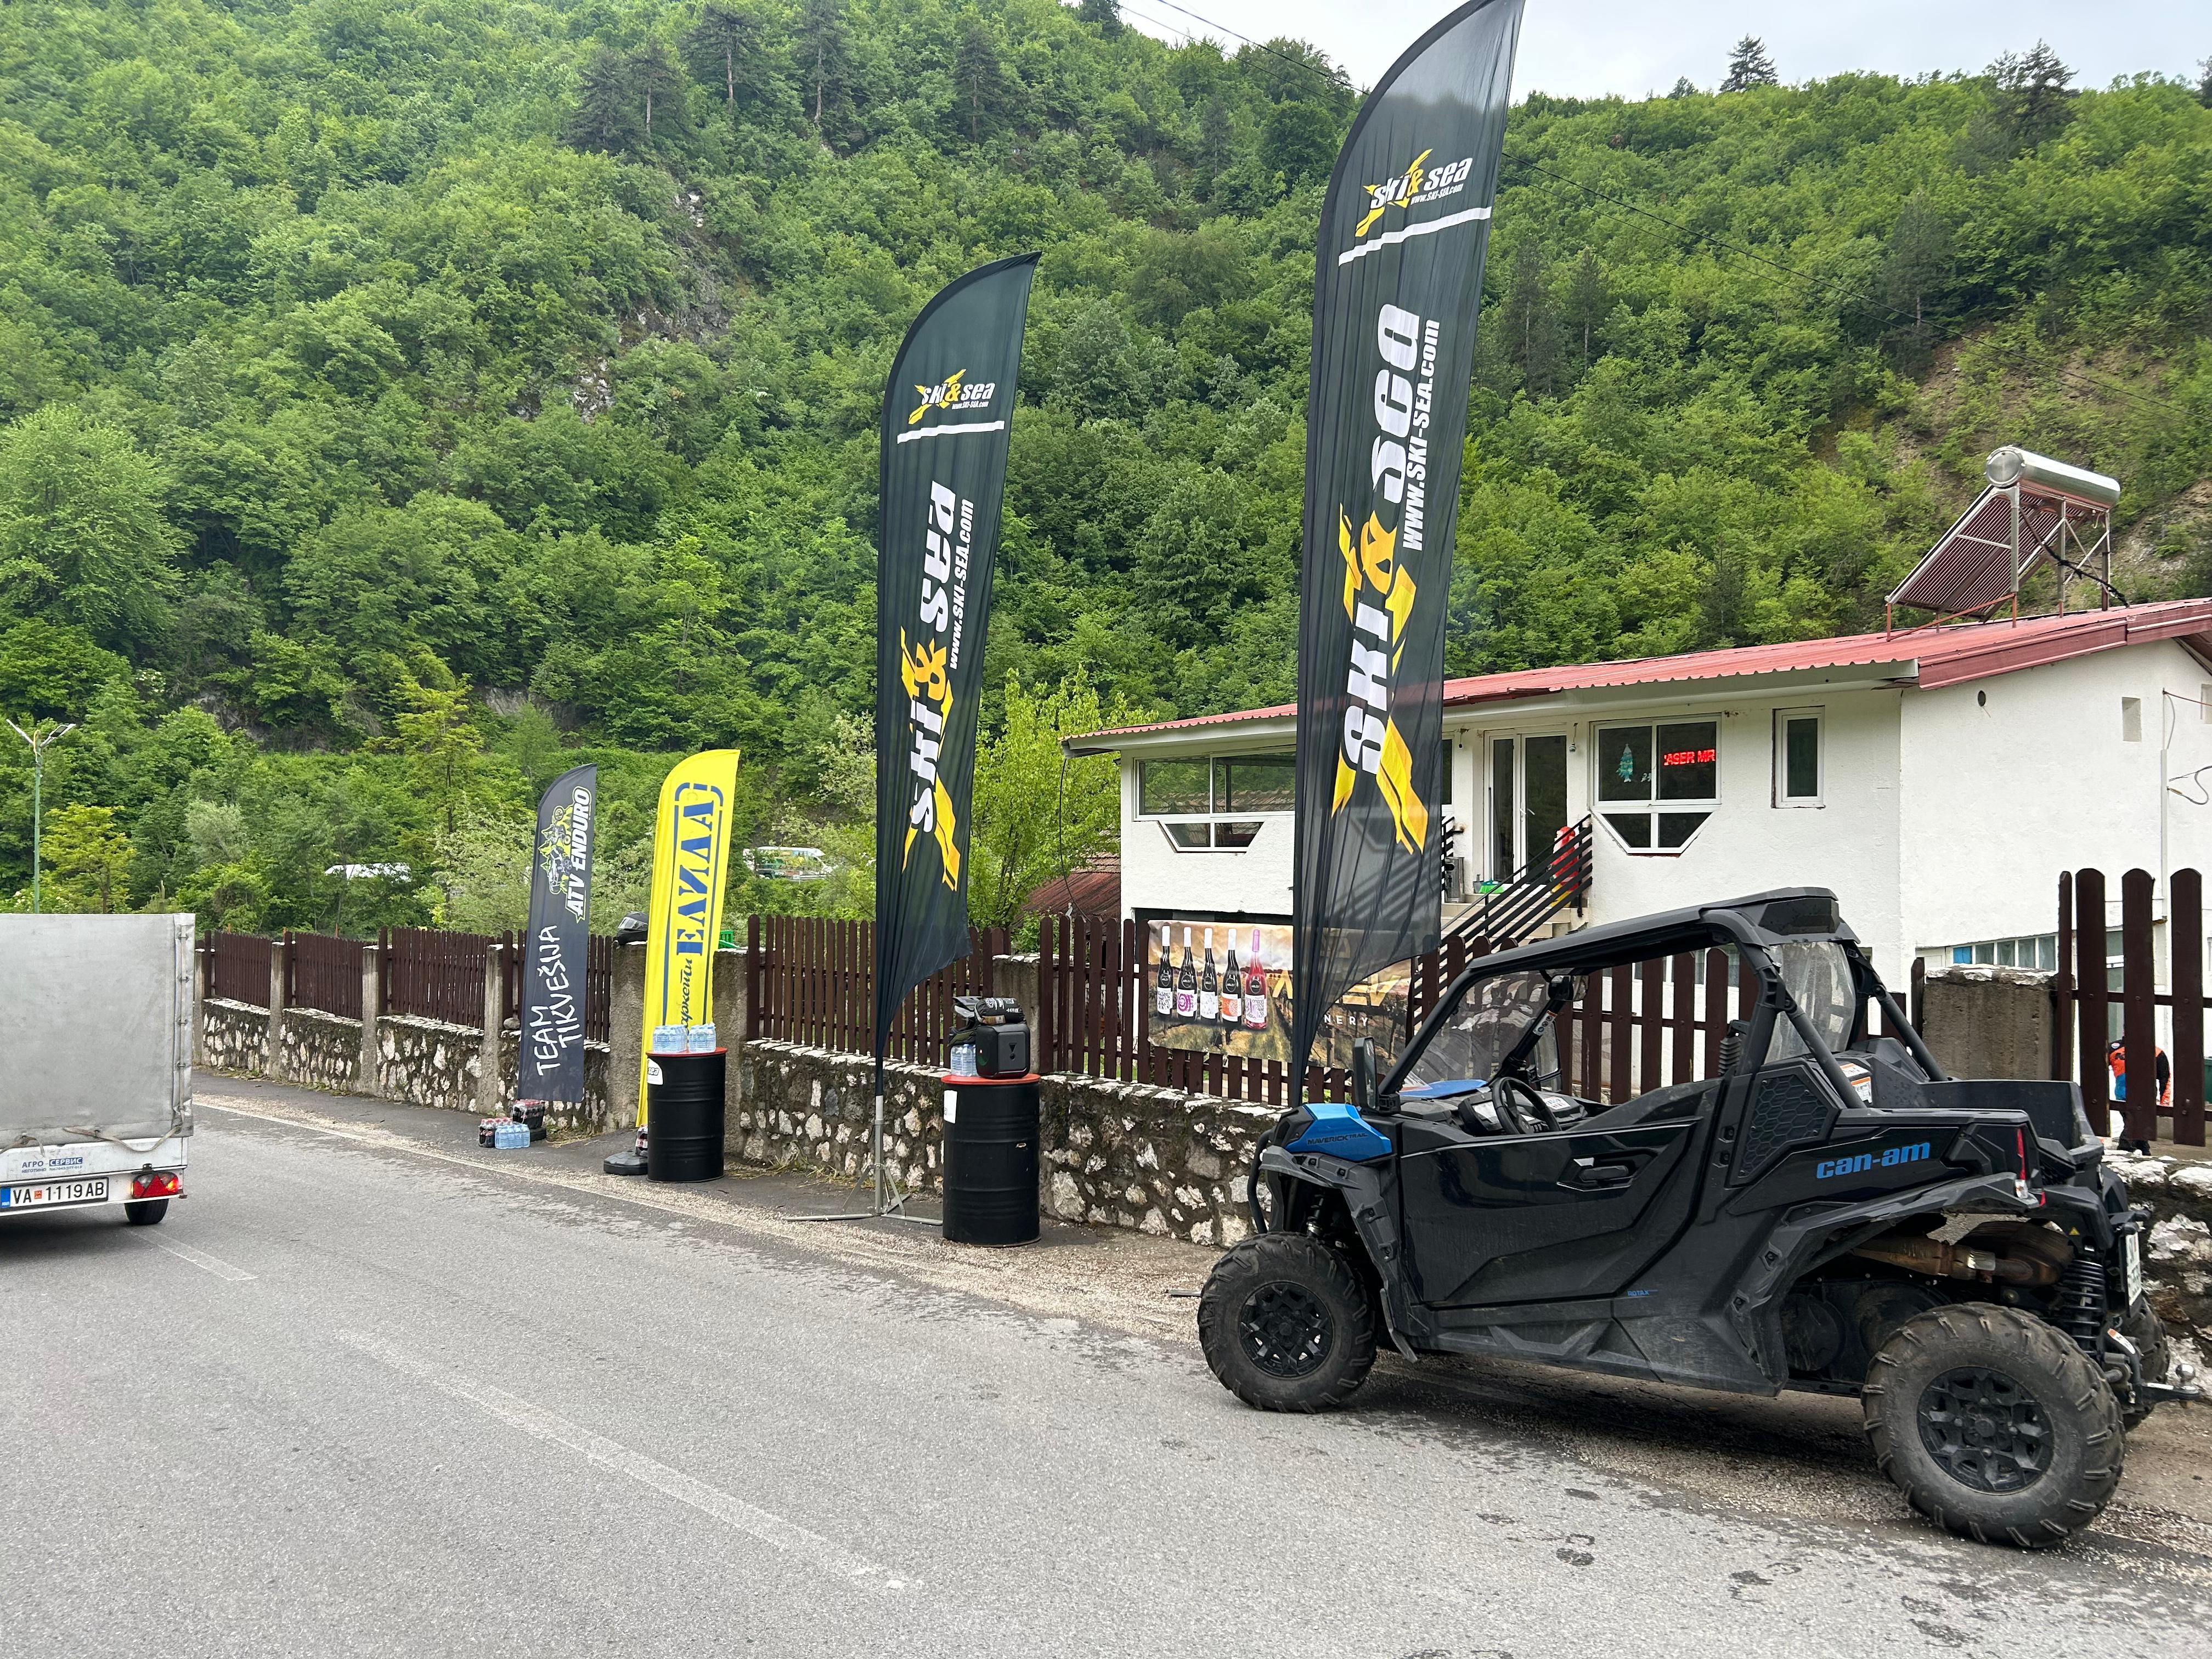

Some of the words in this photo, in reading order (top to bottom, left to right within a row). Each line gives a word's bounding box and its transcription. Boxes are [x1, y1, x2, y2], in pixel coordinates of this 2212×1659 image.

[571, 788, 590, 872] ENDURO
[567, 873, 585, 917] ATV
[537, 925, 582, 1048] TIKVEŠIJA
[680, 958, 693, 1034] аркети
[529, 1006, 561, 1076] TEAM
[49, 1157, 82, 1166] СЕРВИС
[1307, 1135, 1348, 1145] MAVERICK
[1816, 1142, 1930, 1179] can-am
[13, 1188, 32, 1204] VA
